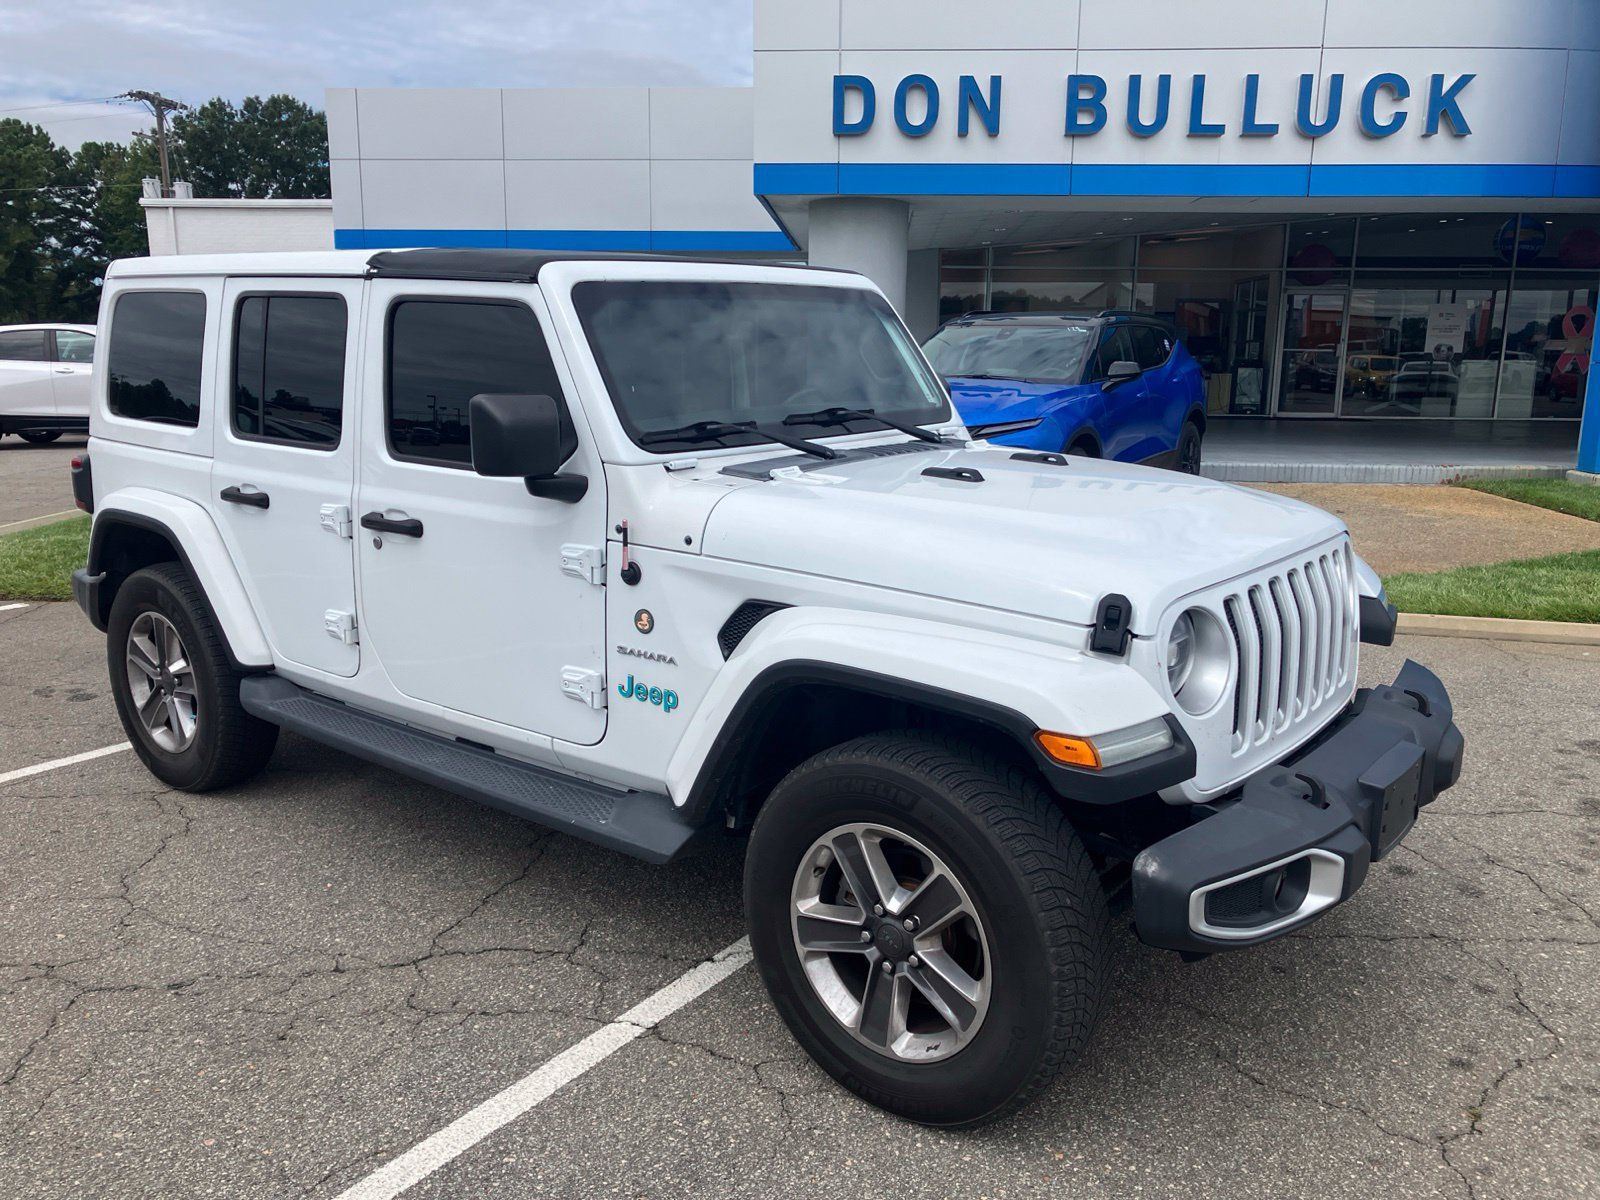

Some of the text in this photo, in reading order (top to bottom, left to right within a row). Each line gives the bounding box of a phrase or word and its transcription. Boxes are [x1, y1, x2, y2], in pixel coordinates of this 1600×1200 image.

[832, 72, 1476, 138] DON BULLUCK
[616, 645, 678, 666] SAHARA
[617, 675, 678, 712] Jeep
